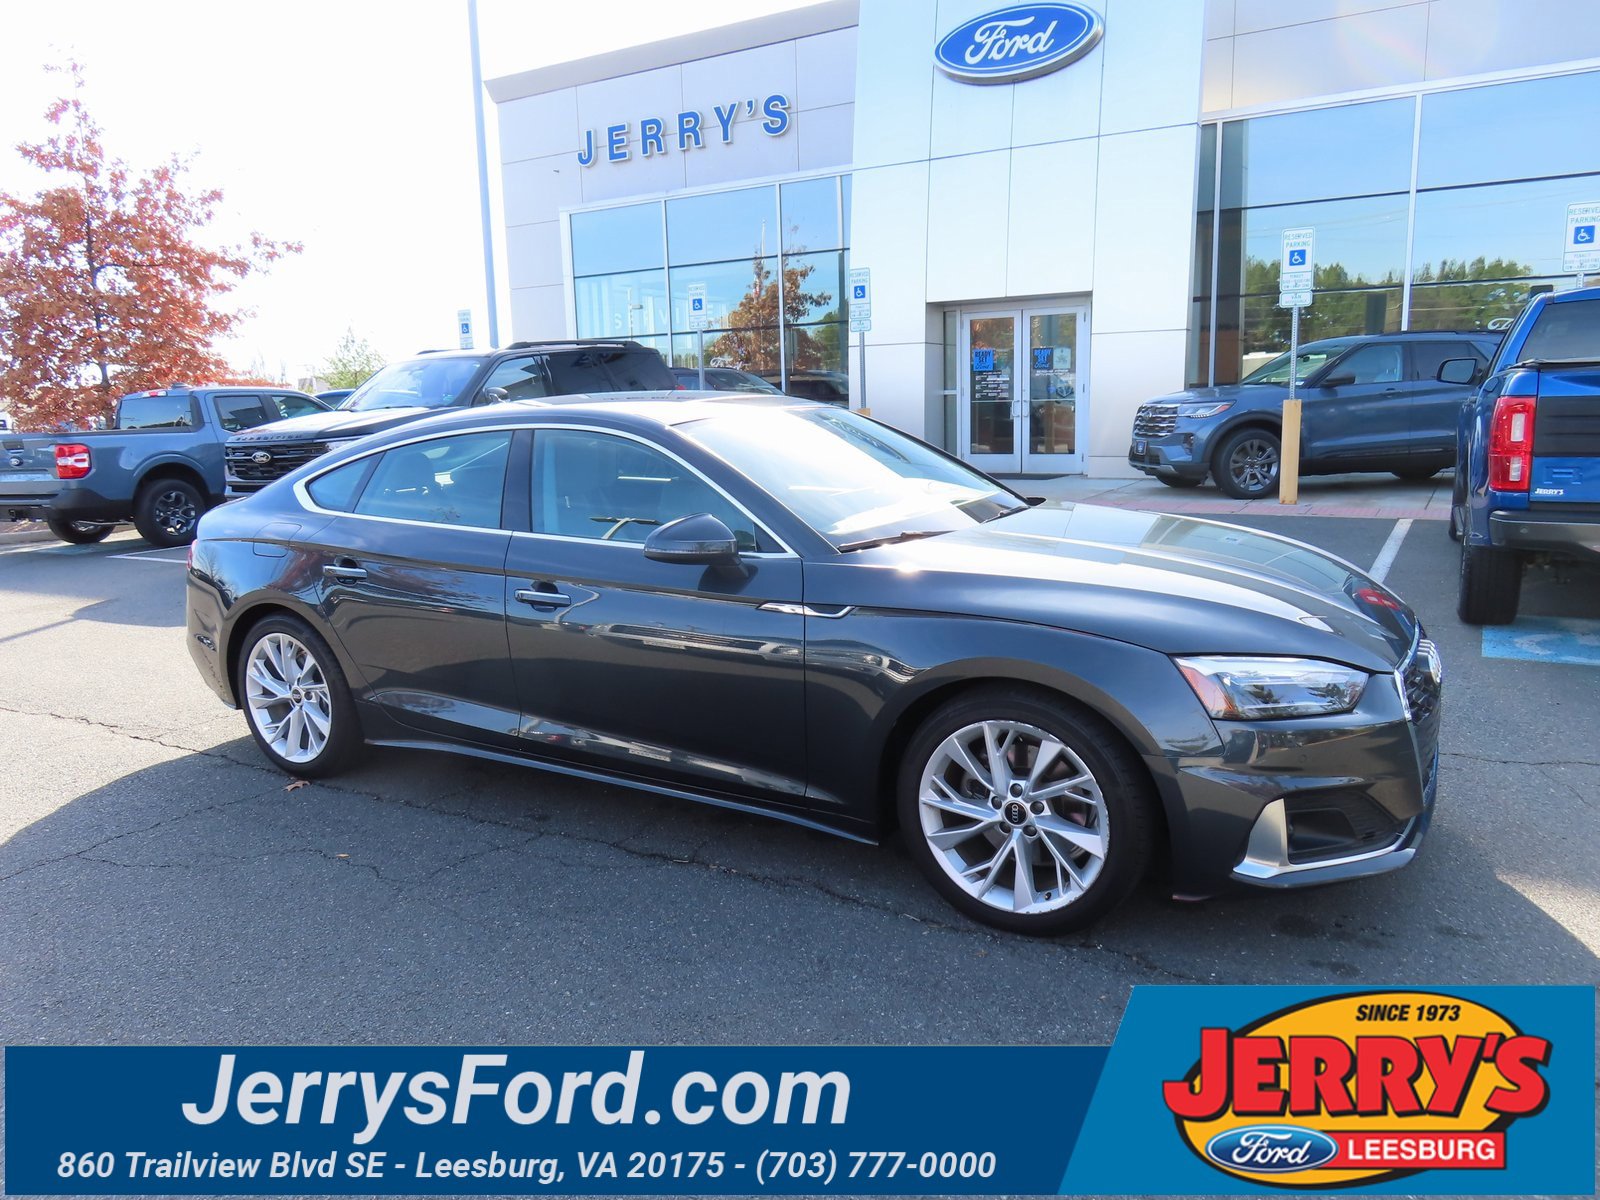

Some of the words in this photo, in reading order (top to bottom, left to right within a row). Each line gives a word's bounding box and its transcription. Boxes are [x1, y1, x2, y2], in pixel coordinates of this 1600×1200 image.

[964, 16, 1058, 64] Ford
[577, 93, 790, 166] JERRY'S
[1569, 205, 1600, 216] RESERVE
